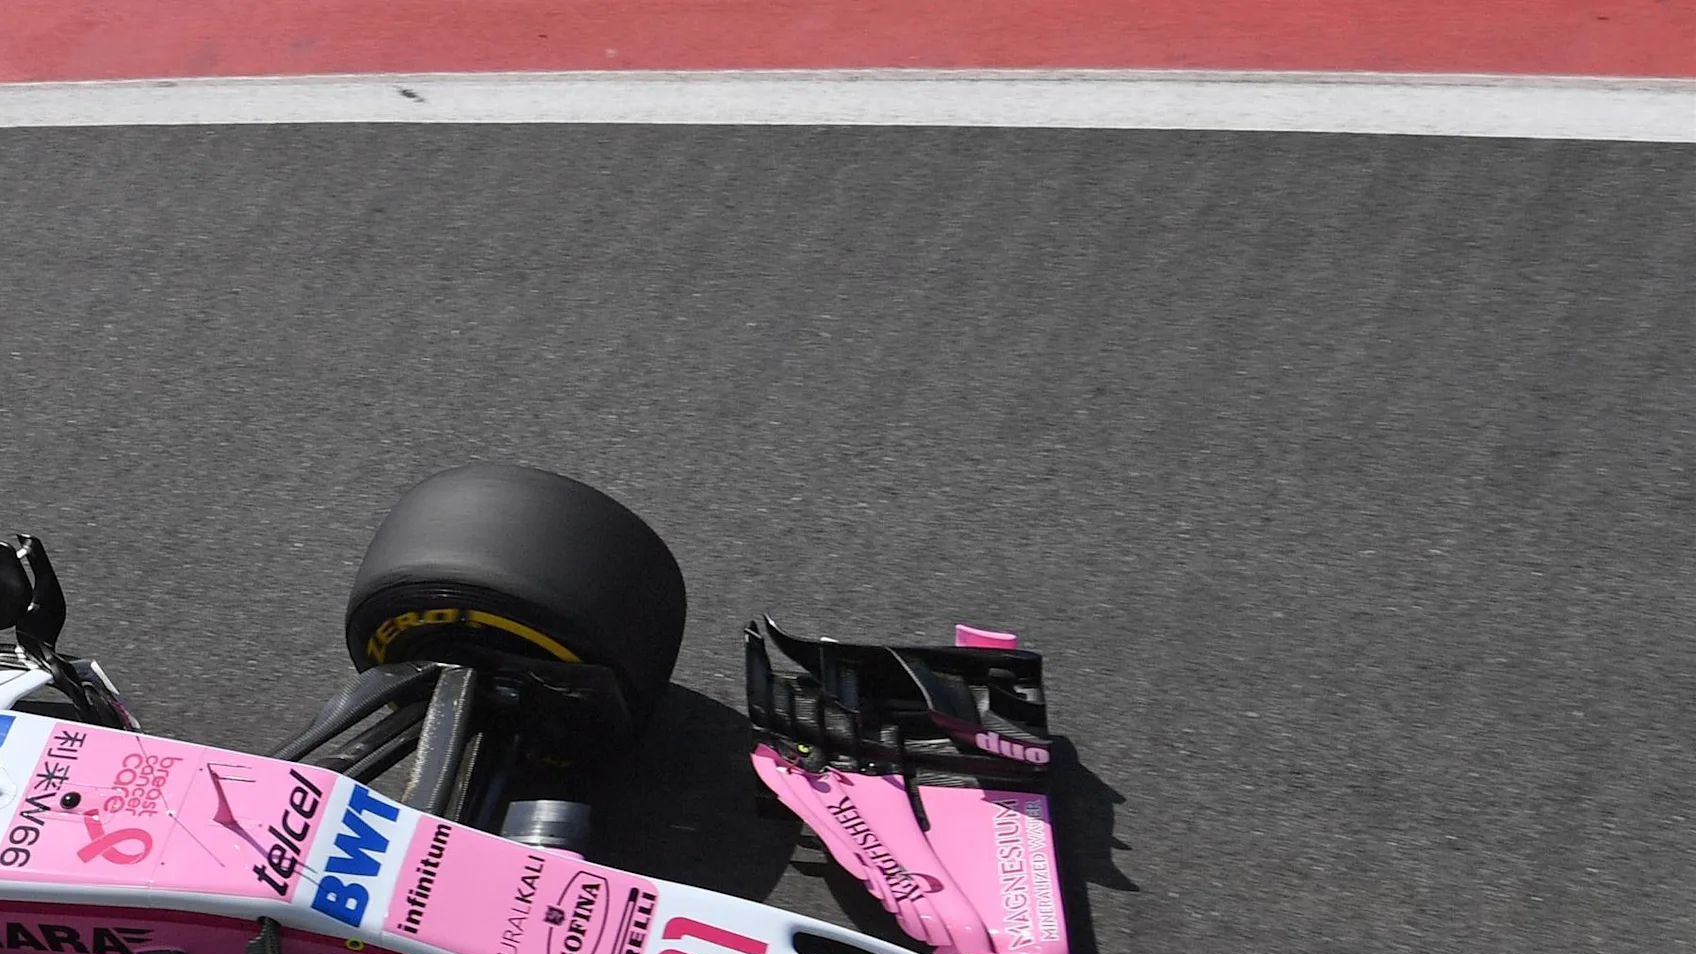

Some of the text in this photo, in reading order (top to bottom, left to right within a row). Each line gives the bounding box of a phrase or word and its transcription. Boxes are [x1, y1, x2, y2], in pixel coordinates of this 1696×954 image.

[103, 753, 143, 814] care
[125, 755, 158, 816] cancer
[137, 756, 183, 817] breast
[975, 731, 1051, 764] duo
[253, 768, 323, 896] telcel
[311, 783, 400, 928] BWT
[992, 798, 1036, 951] MAGNESIUM
[397, 823, 452, 934] infinitum
